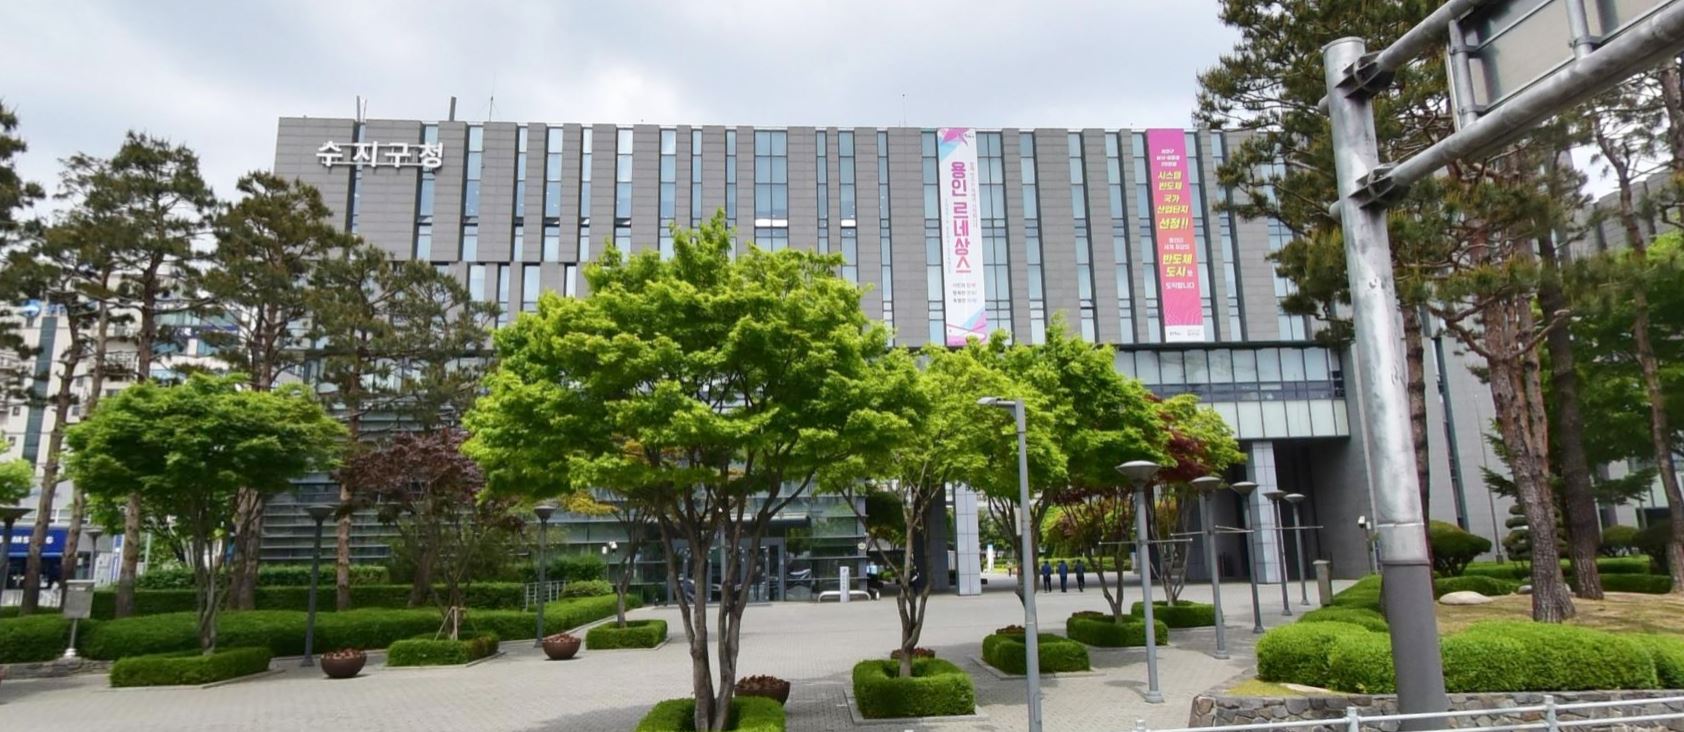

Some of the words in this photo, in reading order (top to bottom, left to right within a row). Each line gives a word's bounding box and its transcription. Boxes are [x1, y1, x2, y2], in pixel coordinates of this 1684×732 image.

[316, 140, 444, 168] 수지구청
[951, 161, 967, 197] 용인
[1158, 171, 1182, 180] 시스템
[1158, 181, 1183, 191] 반도체
[1163, 194, 1180, 203] 국가
[1157, 205, 1189, 214] 산업단지
[1159, 217, 1189, 230] 선정!!
[953, 201, 972, 273] 르네상스
[1162, 253, 1193, 265] 반도체
